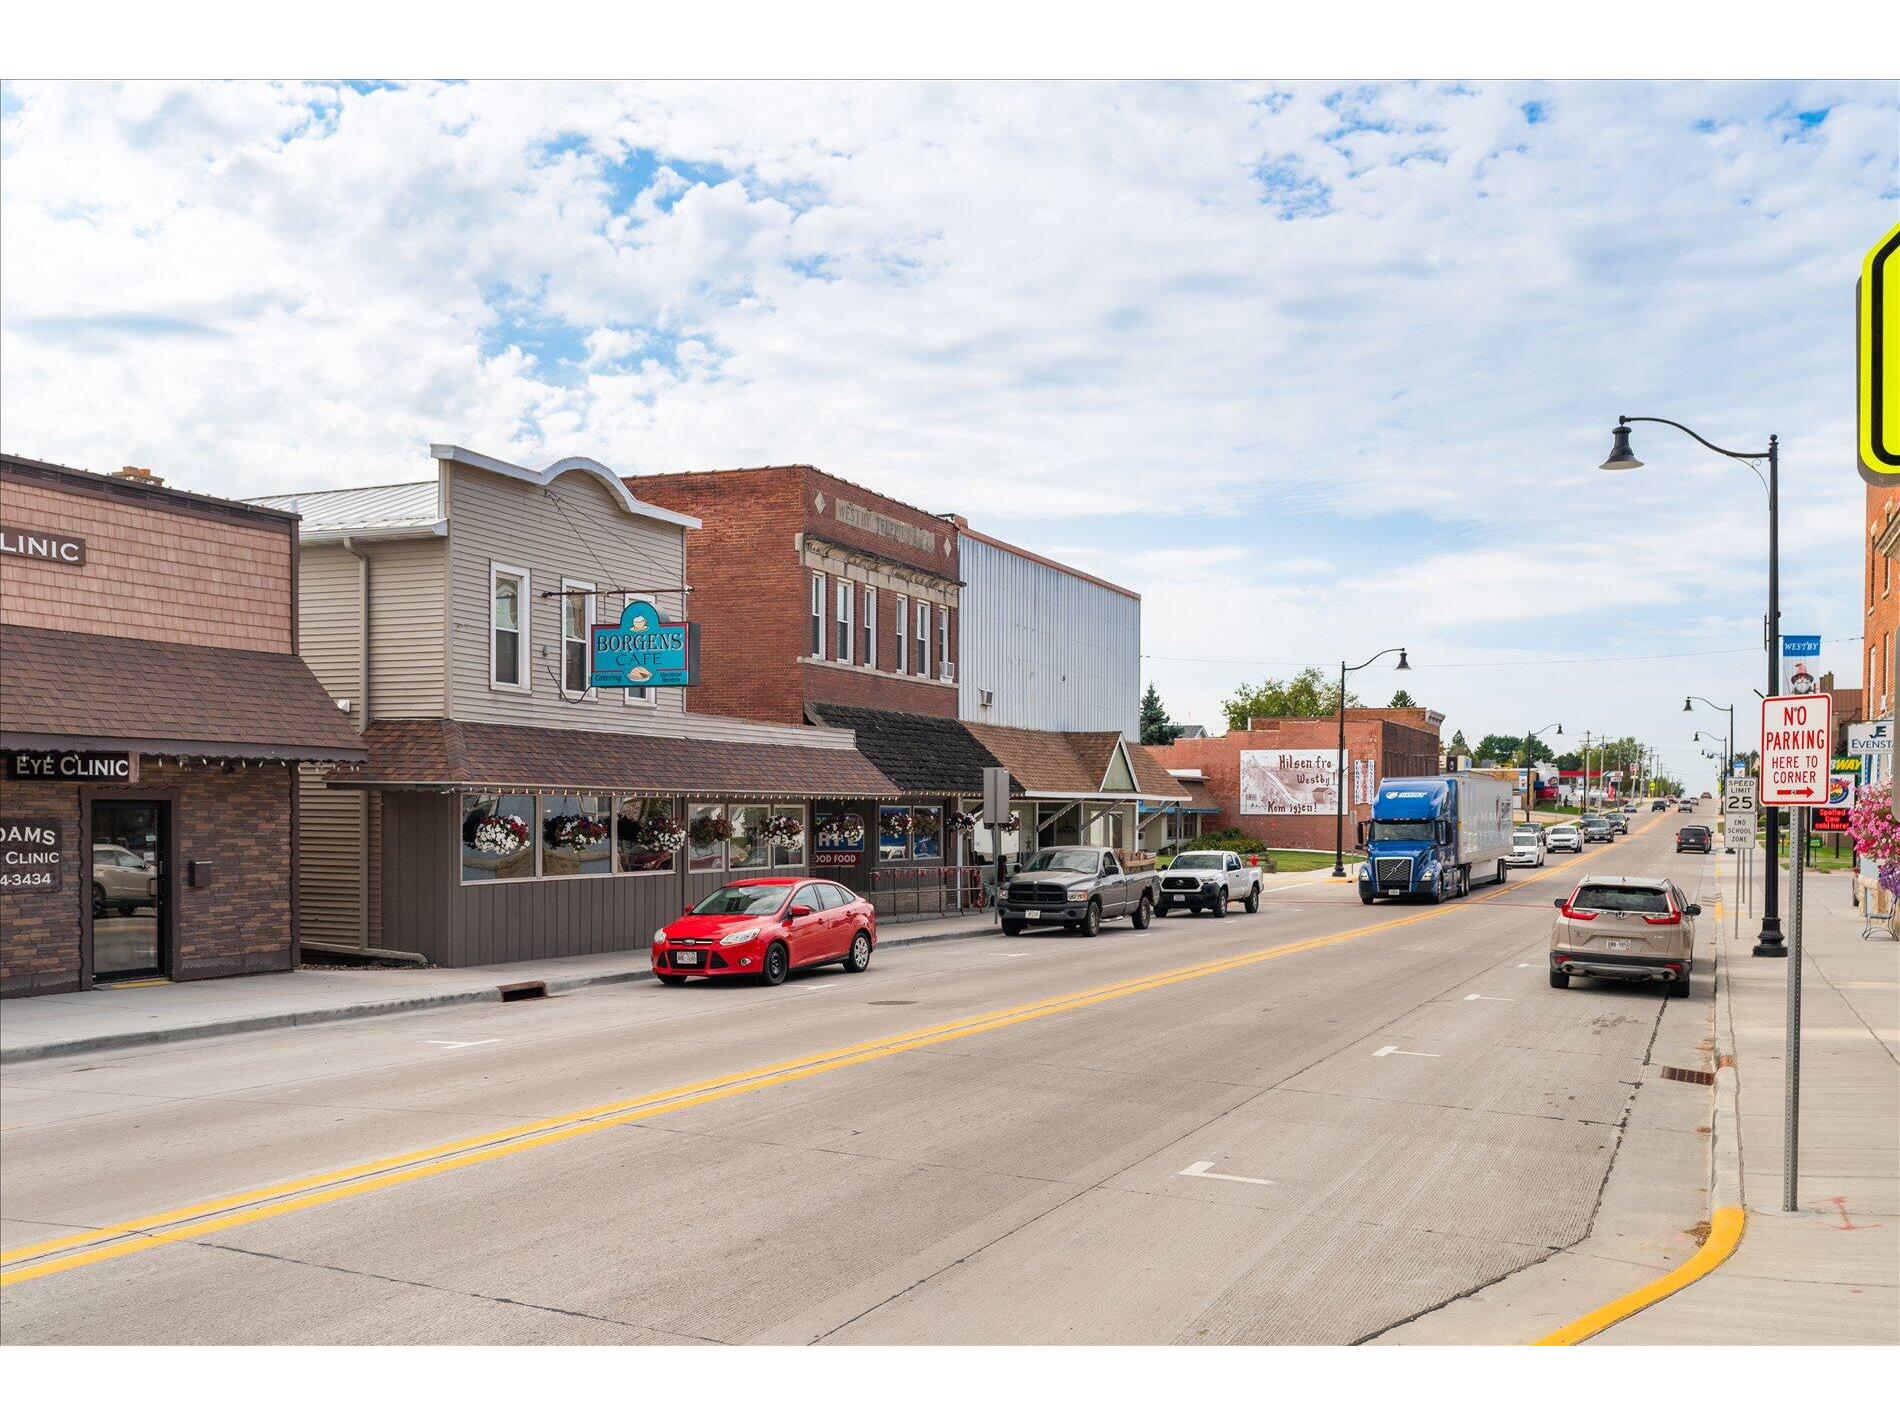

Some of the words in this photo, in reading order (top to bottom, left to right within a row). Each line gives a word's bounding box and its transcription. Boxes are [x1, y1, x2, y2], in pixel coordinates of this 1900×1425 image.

[597, 633, 683, 653] BORGENS
[1784, 641, 1819, 651] WESTBY
[616, 653, 662, 666] CAFE
[595, 674, 622, 683] Catering
[1783, 706, 1807, 726] NO
[1766, 729, 1825, 750] PARKING
[1851, 739, 1893, 749] EVENST
[16, 755, 55, 775] EYE
[60, 755, 128, 777] CLINIC
[1278, 754, 1312, 770] Hilsen
[1772, 756, 1800, 769] HERE
[1805, 756, 1819, 769] TO
[1773, 771, 1817, 784] CORNER
[1267, 801, 1286, 813] Kom
[1728, 796, 1753, 809] 25
[1819, 808, 1846, 817] Spotted
[1734, 818, 1746, 826] END
[1728, 827, 1752, 835] SCHOOL
[6, 851, 59, 865] CLINIC
[833, 855, 856, 863] FOOD
[0, 872, 51, 886] 4-3434
